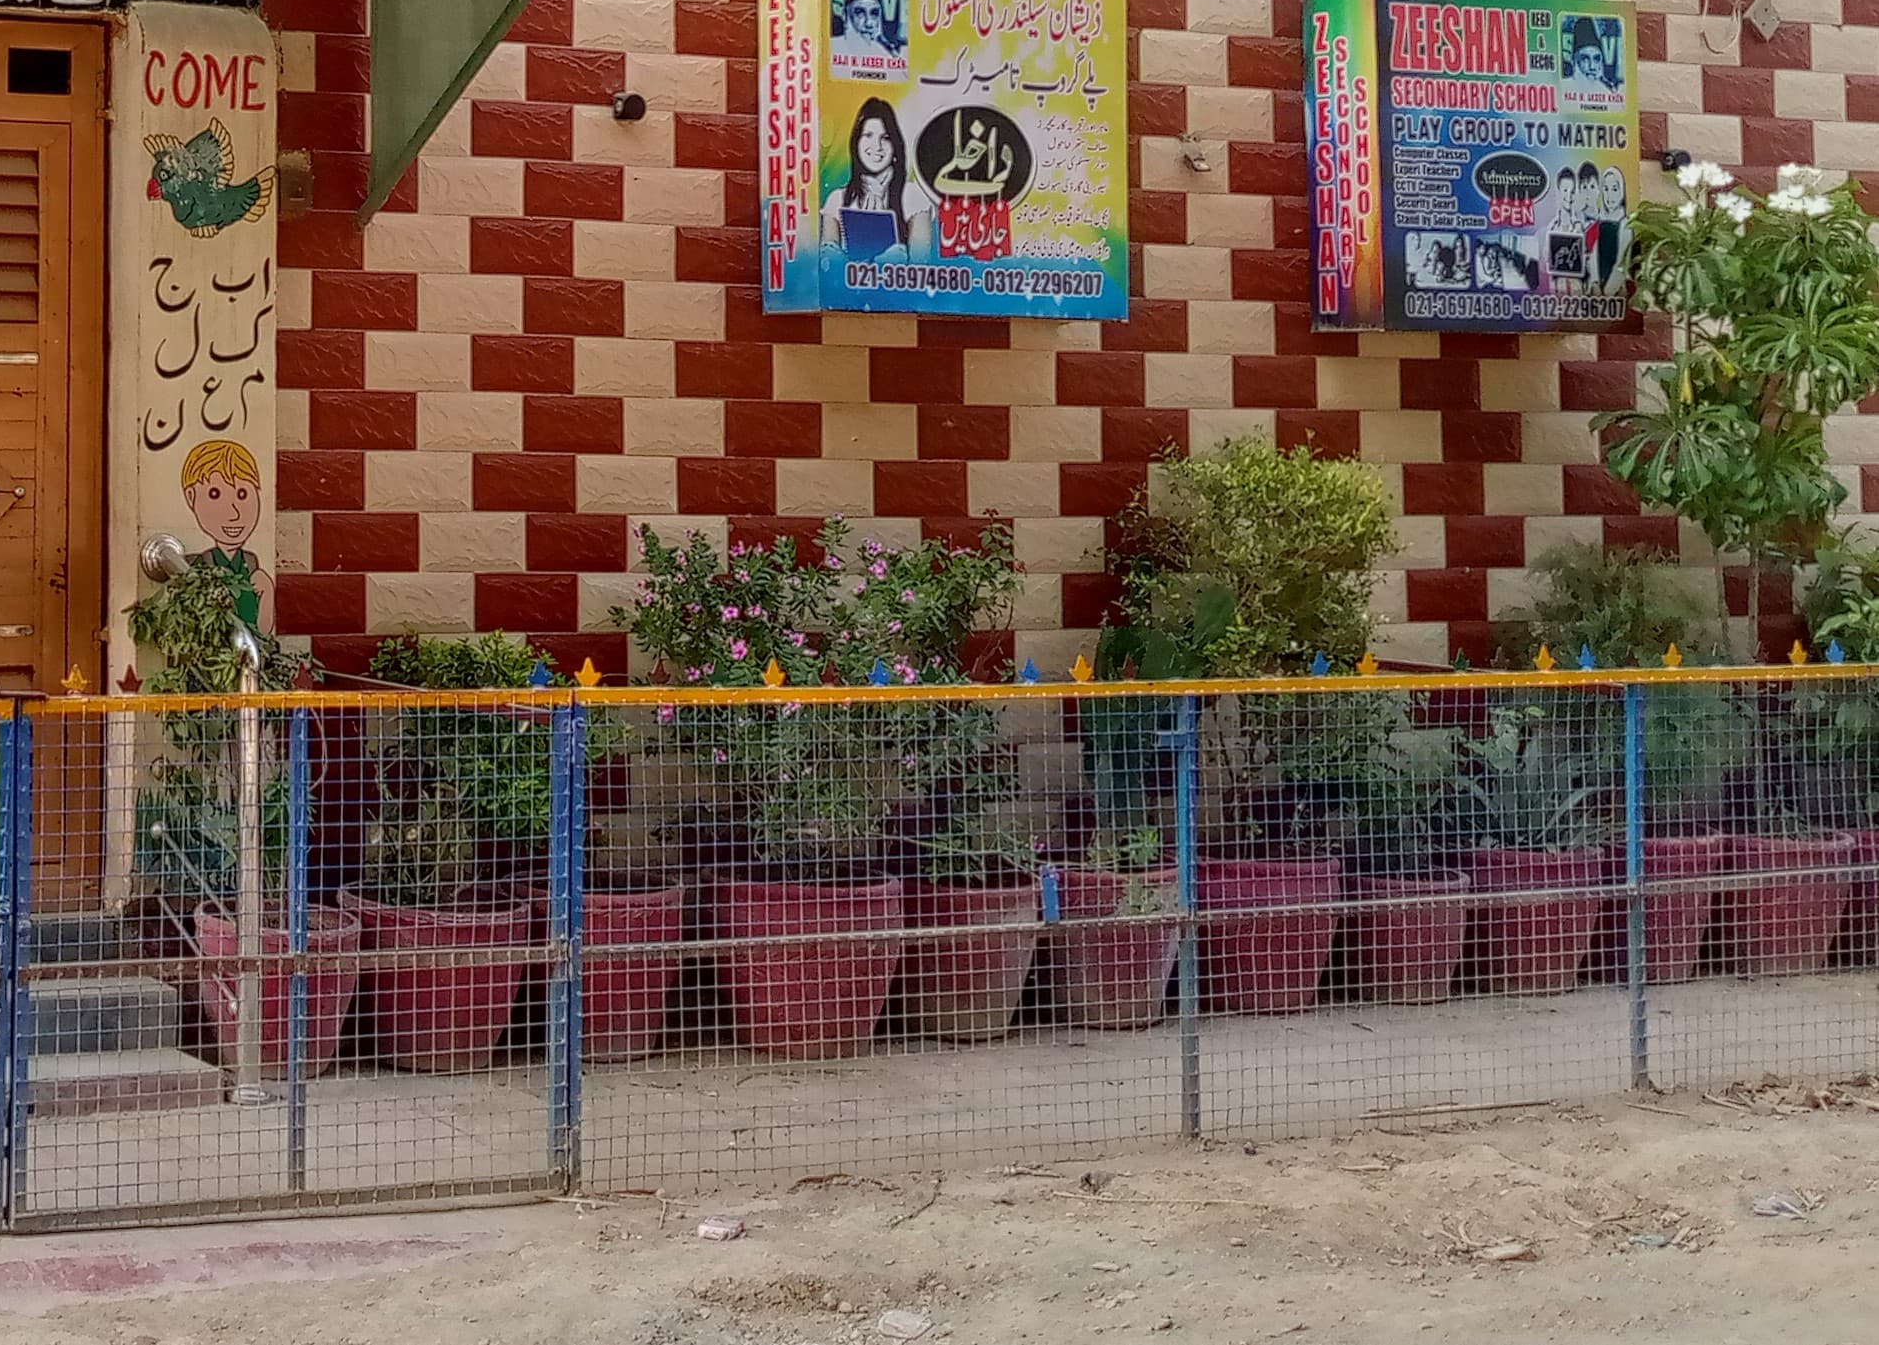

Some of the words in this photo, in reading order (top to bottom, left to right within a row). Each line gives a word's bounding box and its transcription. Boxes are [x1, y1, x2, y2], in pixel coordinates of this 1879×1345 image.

[1389, 2, 1528, 76] ZEESHAN
[144, 50, 266, 111] COME
[1393, 77, 1492, 112] SECONDARY
[1494, 83, 1559, 114] SCHOOL
[800, 37, 812, 215] SCHOOL
[1393, 114, 1442, 143] PLAY
[1451, 118, 1516, 147] GROUP
[1524, 120, 1549, 147] TO
[1558, 123, 1627, 149] MATRIC
[1315, 12, 1339, 314] ZEESHAN
[1334, 36, 1354, 288] SECONDARY
[1353, 77, 1370, 244] SCHOOL
[1481, 169, 1542, 186] Admissions
[1489, 205, 1535, 225] OPEN
[846, 263, 971, 292] 021-36974680
[984, 269, 1103, 297] 0312-2296207
[1407, 295, 1511, 316] 021-36974680
[1524, 297, 1624, 318] 0312-2296207
